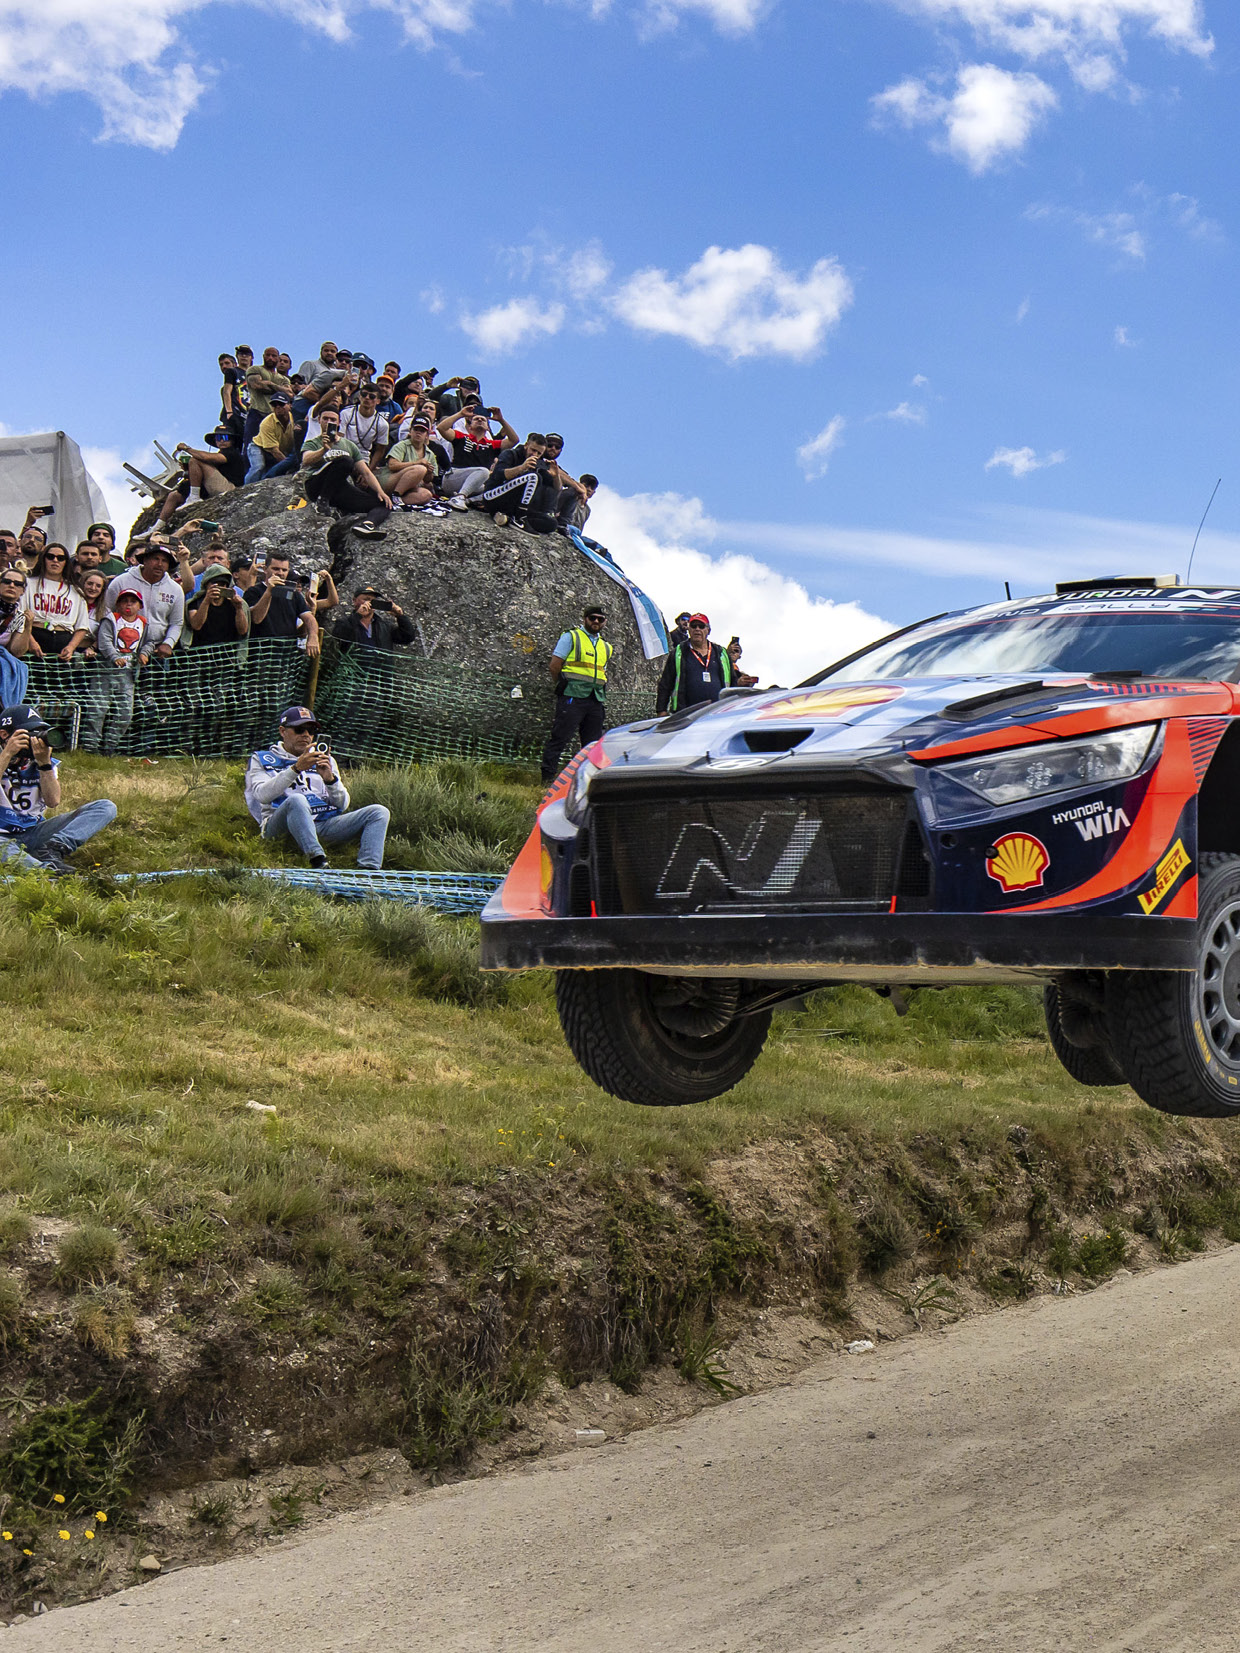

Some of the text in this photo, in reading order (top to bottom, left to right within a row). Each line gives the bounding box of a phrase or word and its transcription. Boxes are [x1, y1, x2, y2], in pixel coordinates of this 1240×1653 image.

[33, 593, 73, 616] CHICAGO
[2, 717, 12, 726] 23
[1052, 801, 1104, 825] HYUNDAI
[1145, 848, 1184, 906] PIRELLI
